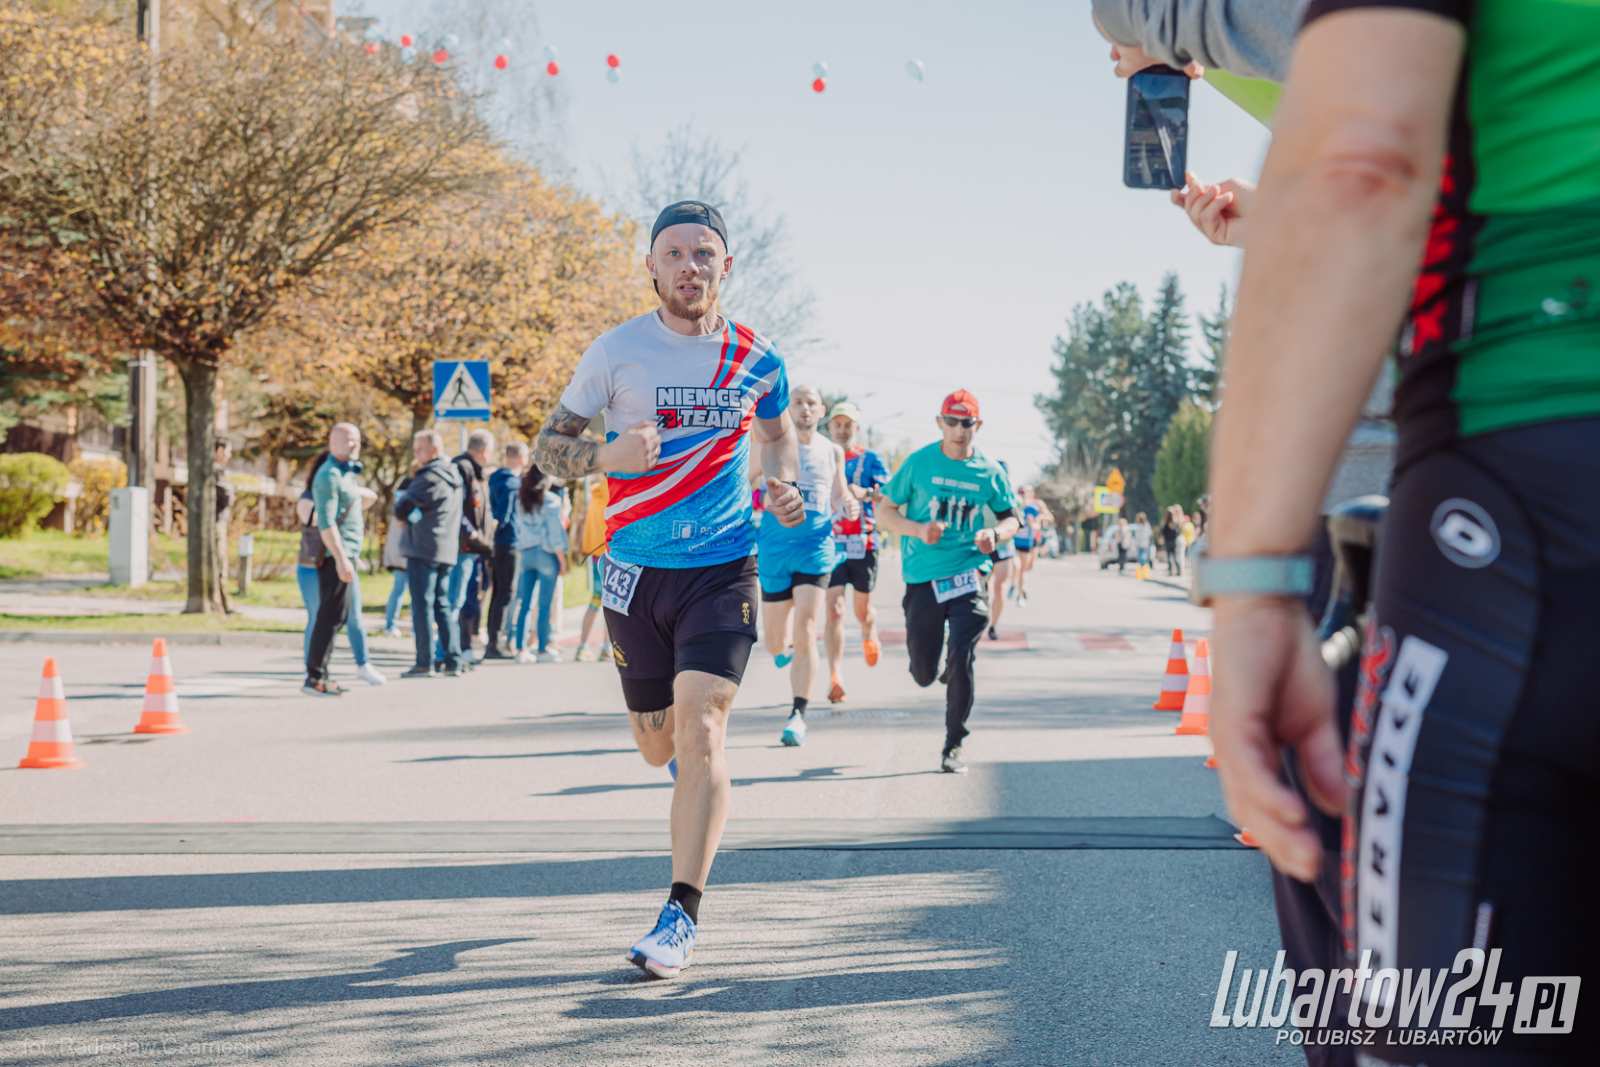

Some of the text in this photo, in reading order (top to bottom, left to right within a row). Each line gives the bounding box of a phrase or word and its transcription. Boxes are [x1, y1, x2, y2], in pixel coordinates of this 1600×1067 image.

[656, 387, 743, 408] NIEMCE
[679, 408, 742, 429] TEAM
[604, 564, 631, 598] 143
